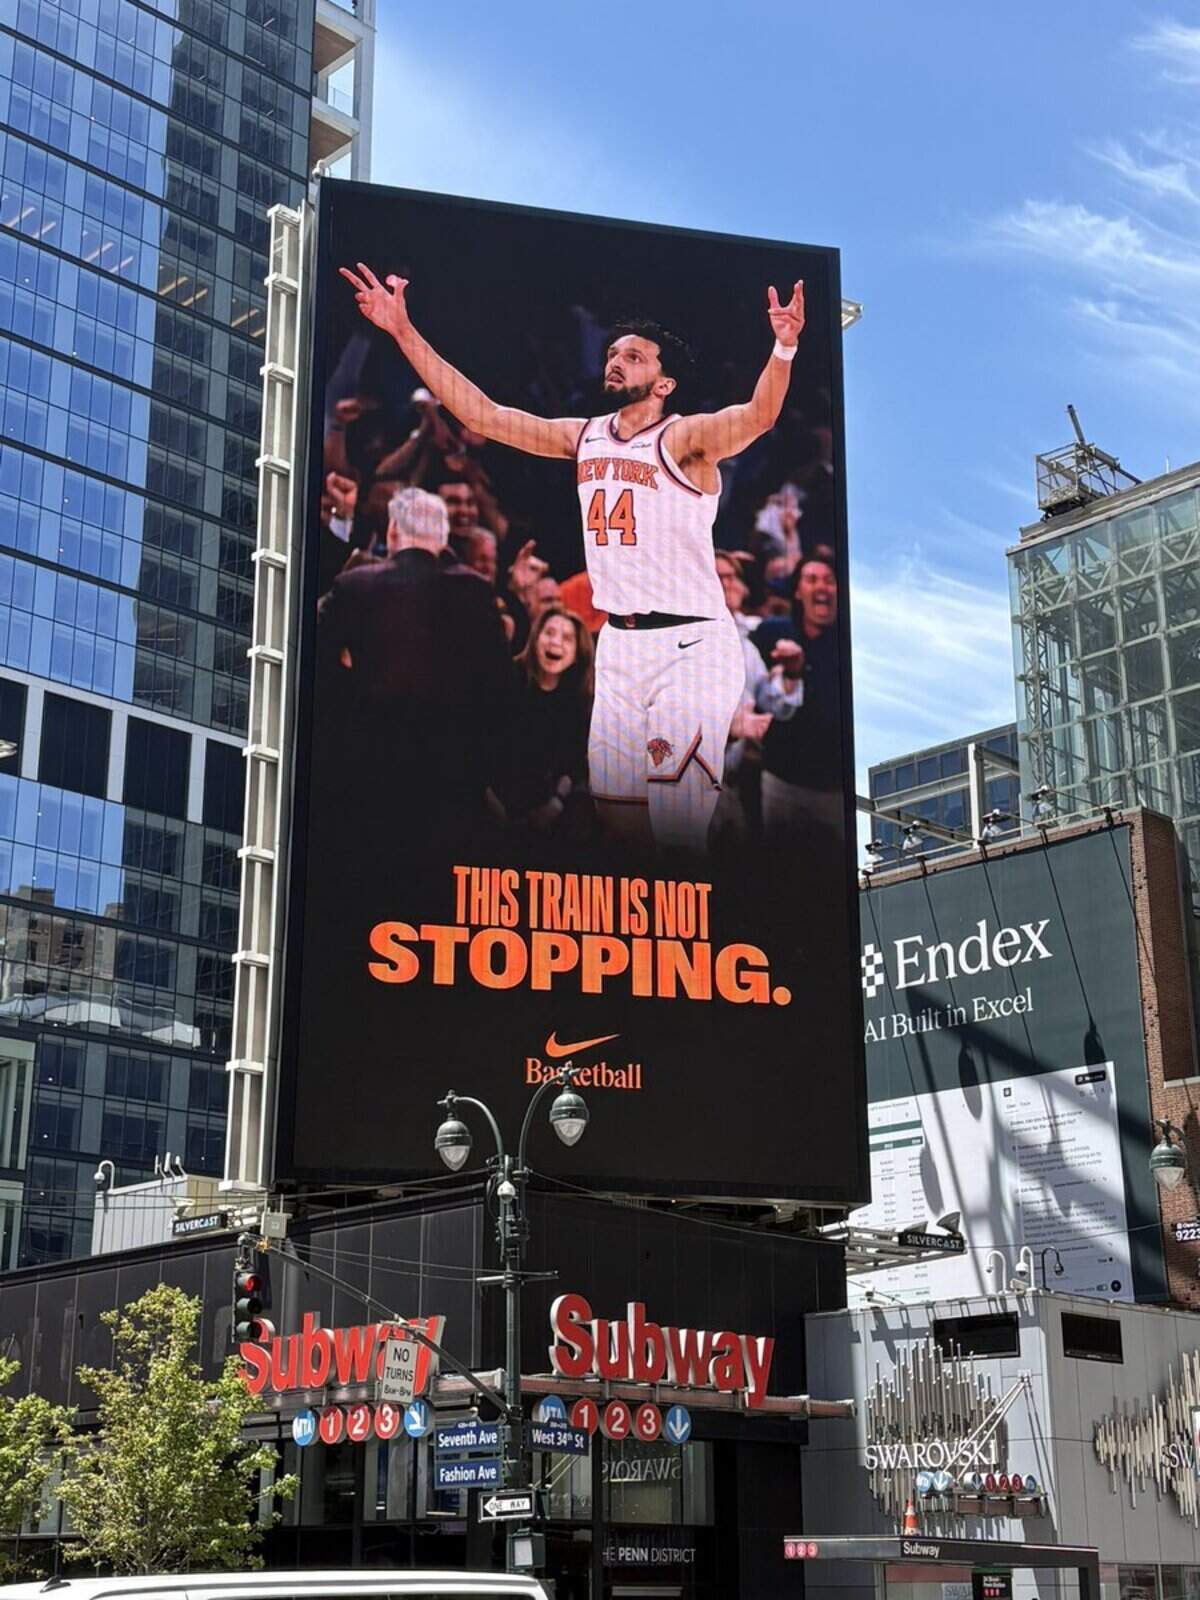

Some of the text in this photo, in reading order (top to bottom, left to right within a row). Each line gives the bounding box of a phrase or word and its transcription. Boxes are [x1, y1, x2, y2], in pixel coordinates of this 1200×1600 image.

[612, 458, 659, 490] YORK
[587, 489, 637, 546] 44
[453, 865, 712, 940] THIS TRAIN IS NOT
[368, 921, 792, 1006] STOPPING.
[893, 918, 1053, 990] Endex
[864, 987, 1034, 1043] AI Built in Excel
[175, 1215, 219, 1233] SILVERCAST
[906, 1234, 960, 1249] SILVERCAST
[393, 1347, 410, 1362] NO
[549, 1294, 775, 1408] Subway
[386, 1366, 413, 1382] TURNS
[611, 1407, 625, 1433] 2
[642, 1408, 656, 1435] 3
[438, 1430, 498, 1448] Seventh Ave
[532, 1428, 585, 1449] West 34th St
[864, 1439, 999, 1470] SWAROVSKI
[440, 1465, 497, 1483] Fashion Ave
[489, 1500, 525, 1511] ONE WAY
[618, 1546, 648, 1562] PENN
[651, 1546, 697, 1563] DISTRICT
[903, 1541, 940, 1559] Subway
